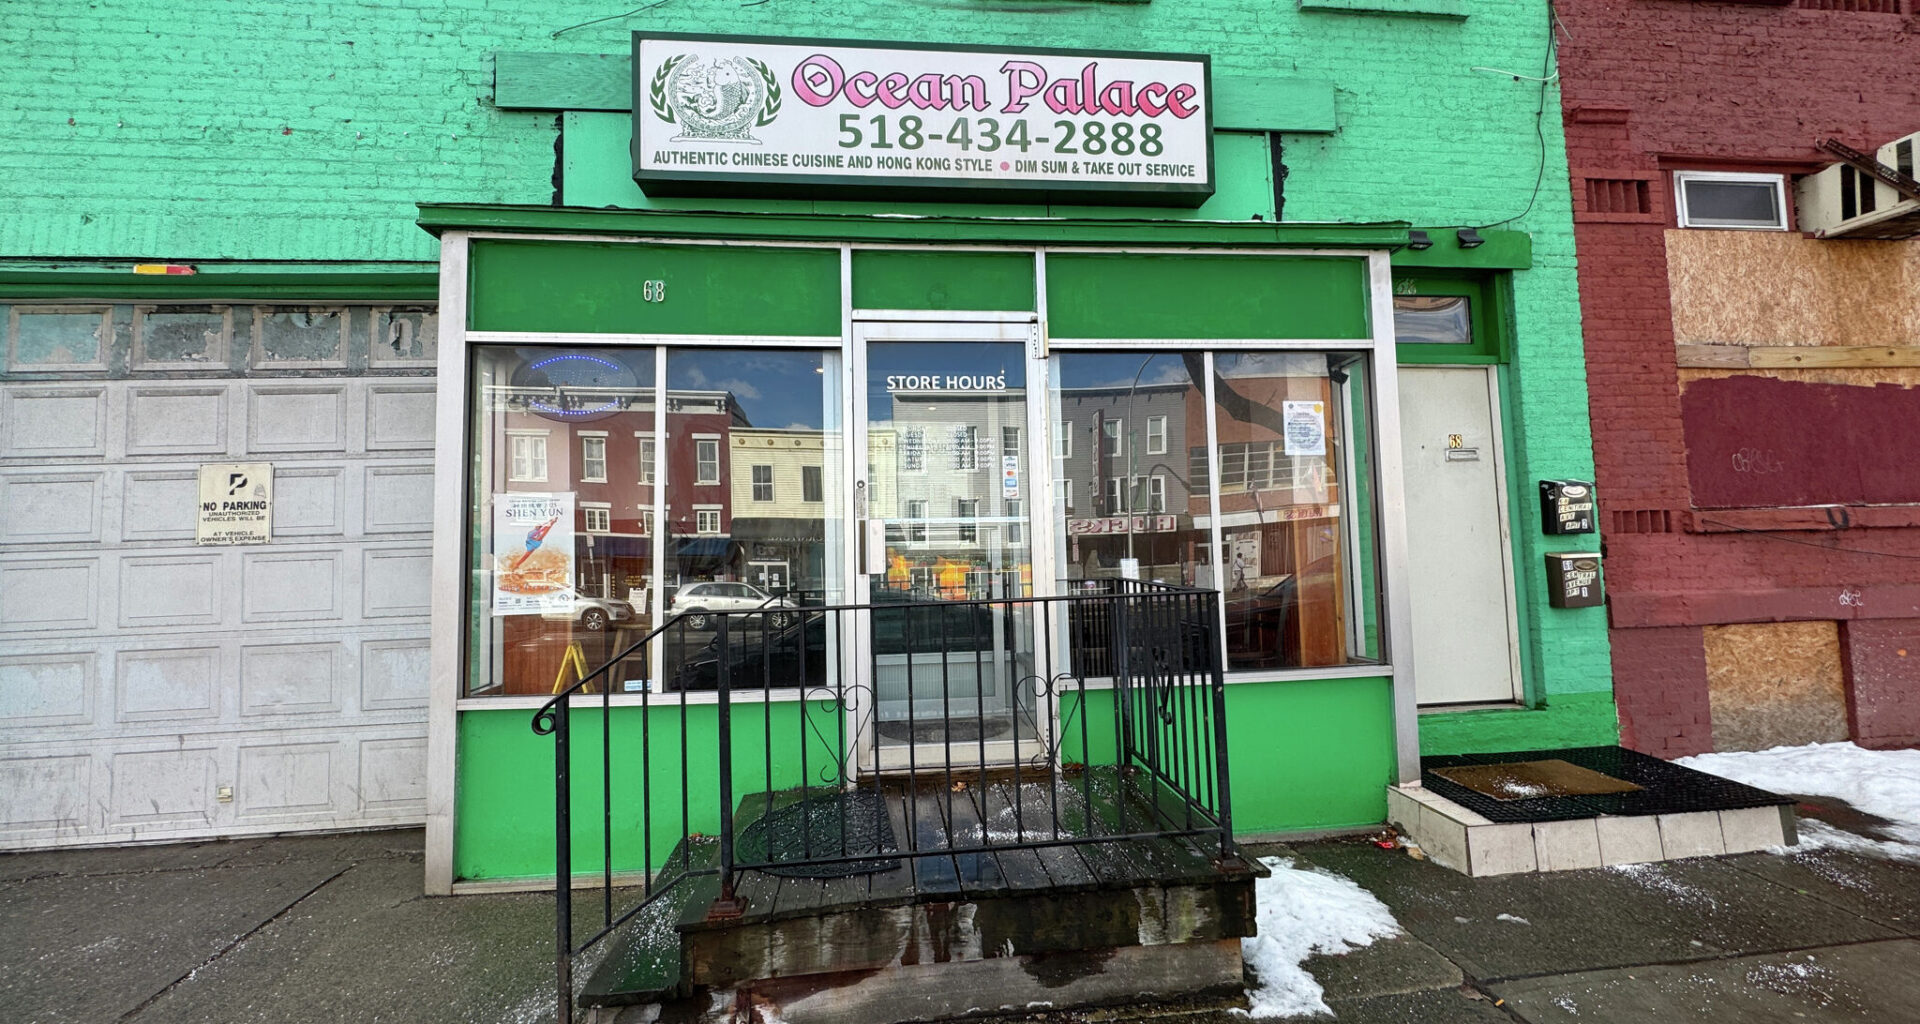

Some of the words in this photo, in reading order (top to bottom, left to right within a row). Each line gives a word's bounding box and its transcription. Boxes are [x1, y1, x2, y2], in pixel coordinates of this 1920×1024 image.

[791, 54, 993, 112] Ocean
[999, 59, 1201, 119] Palace
[838, 114, 1165, 157] 518-434-2888
[653, 151, 728, 165] AUTHENTIC
[732, 153, 788, 166] CHINESE
[792, 154, 844, 167] CUISINE
[847, 156, 873, 168] AND
[877, 157, 912, 170] HONG
[916, 158, 950, 170] KONG
[954, 159, 993, 171] STYLE
[1015, 160, 1038, 173] DIM
[1041, 161, 1068, 173] SUM
[1071, 162, 1079, 173] &
[1083, 162, 1114, 175] TAKE
[1117, 163, 1142, 175] OUT
[1145, 163, 1195, 177] SERVICE
[644, 280, 664, 302] 68
[886, 375, 941, 390] STORE
[946, 375, 1006, 390] HOURS
[1449, 434, 1462, 448] 68
[203, 502, 217, 511] NO
[223, 501, 267, 511] PARKING
[505, 508, 538, 518] SHEN
[541, 507, 564, 517] YUN
[1582, 519, 1587, 529] 2
[1565, 571, 1596, 580] CENTRAL
